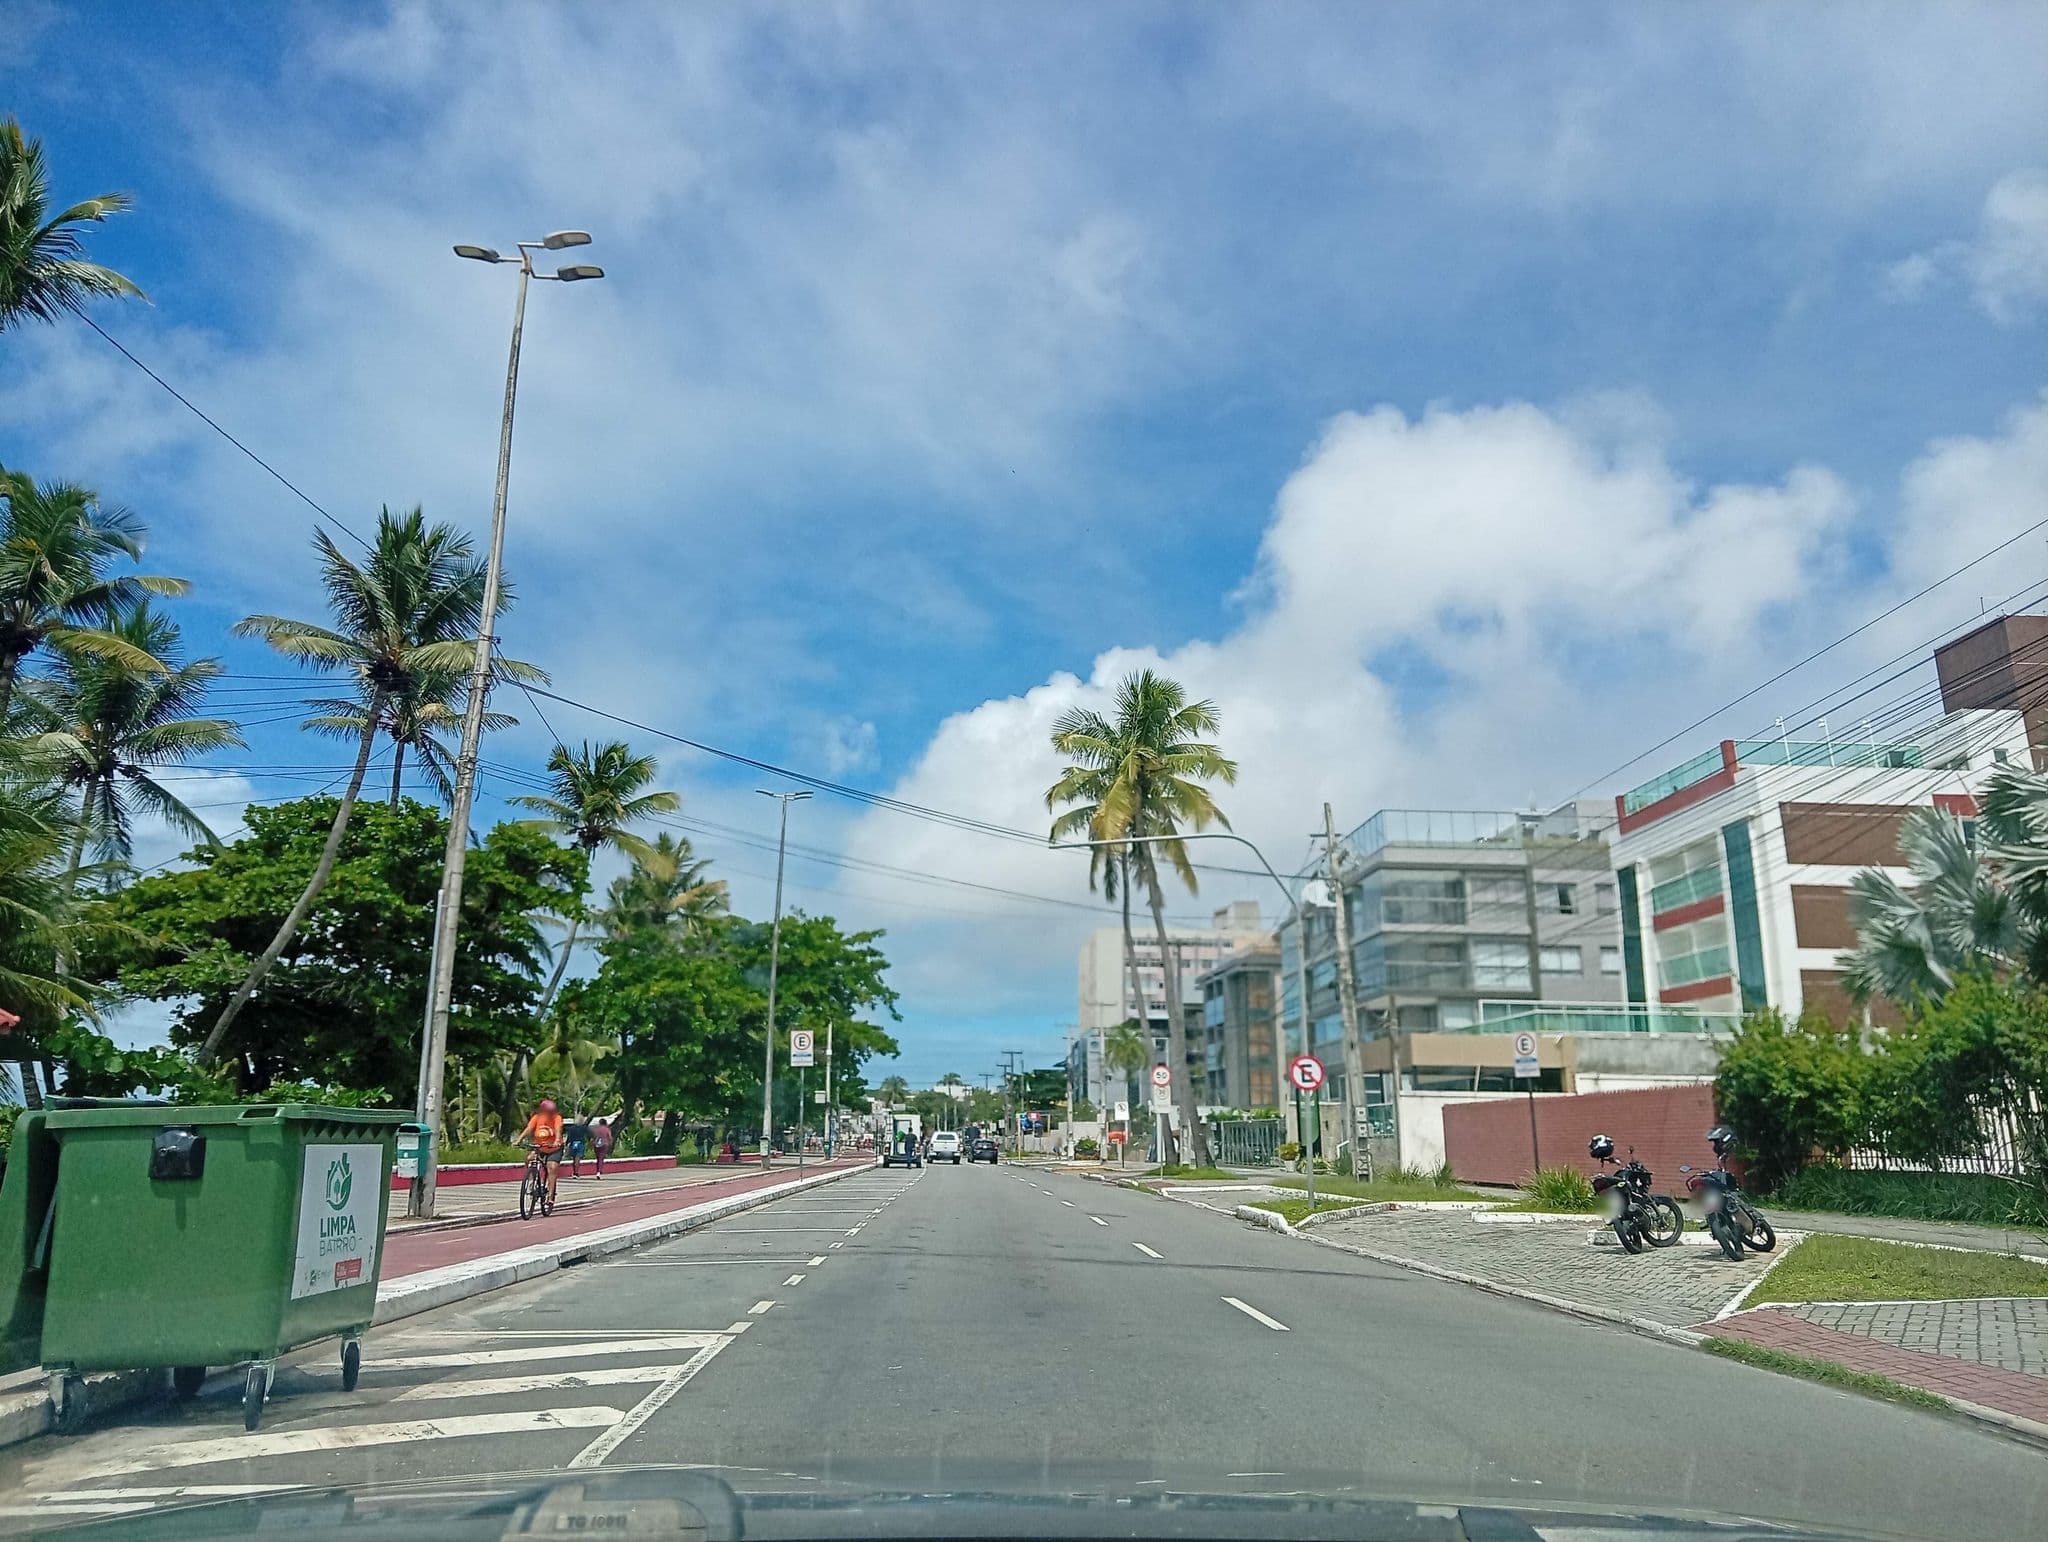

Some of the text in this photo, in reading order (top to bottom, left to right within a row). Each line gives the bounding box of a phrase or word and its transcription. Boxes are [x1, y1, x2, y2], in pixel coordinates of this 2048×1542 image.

[799, 1036, 806, 1047] E
[1521, 1037, 1529, 1051] E
[1156, 1071, 1168, 1079] 50
[1302, 1064, 1313, 1083] E
[320, 1214, 356, 1238] LIMPA
[319, 1236, 357, 1257] BAIRRO
